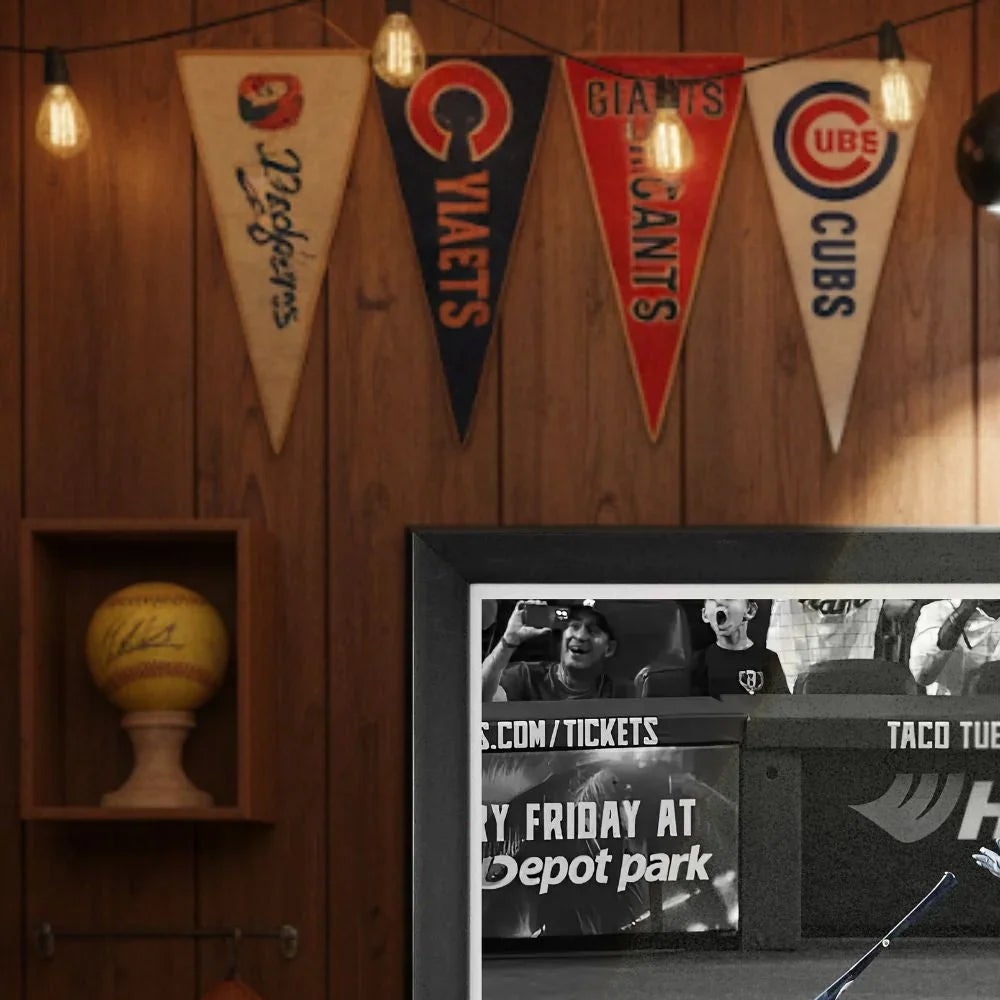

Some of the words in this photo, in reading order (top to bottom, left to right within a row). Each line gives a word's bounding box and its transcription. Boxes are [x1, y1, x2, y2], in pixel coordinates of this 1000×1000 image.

[587, 78, 725, 117] GIATS
[811, 211, 857, 318] CUBS
[887, 721, 949, 749] TACO
[526, 800, 641, 840] FRIDAY
[656, 799, 696, 837] AT
[617, 845, 712, 892] park
